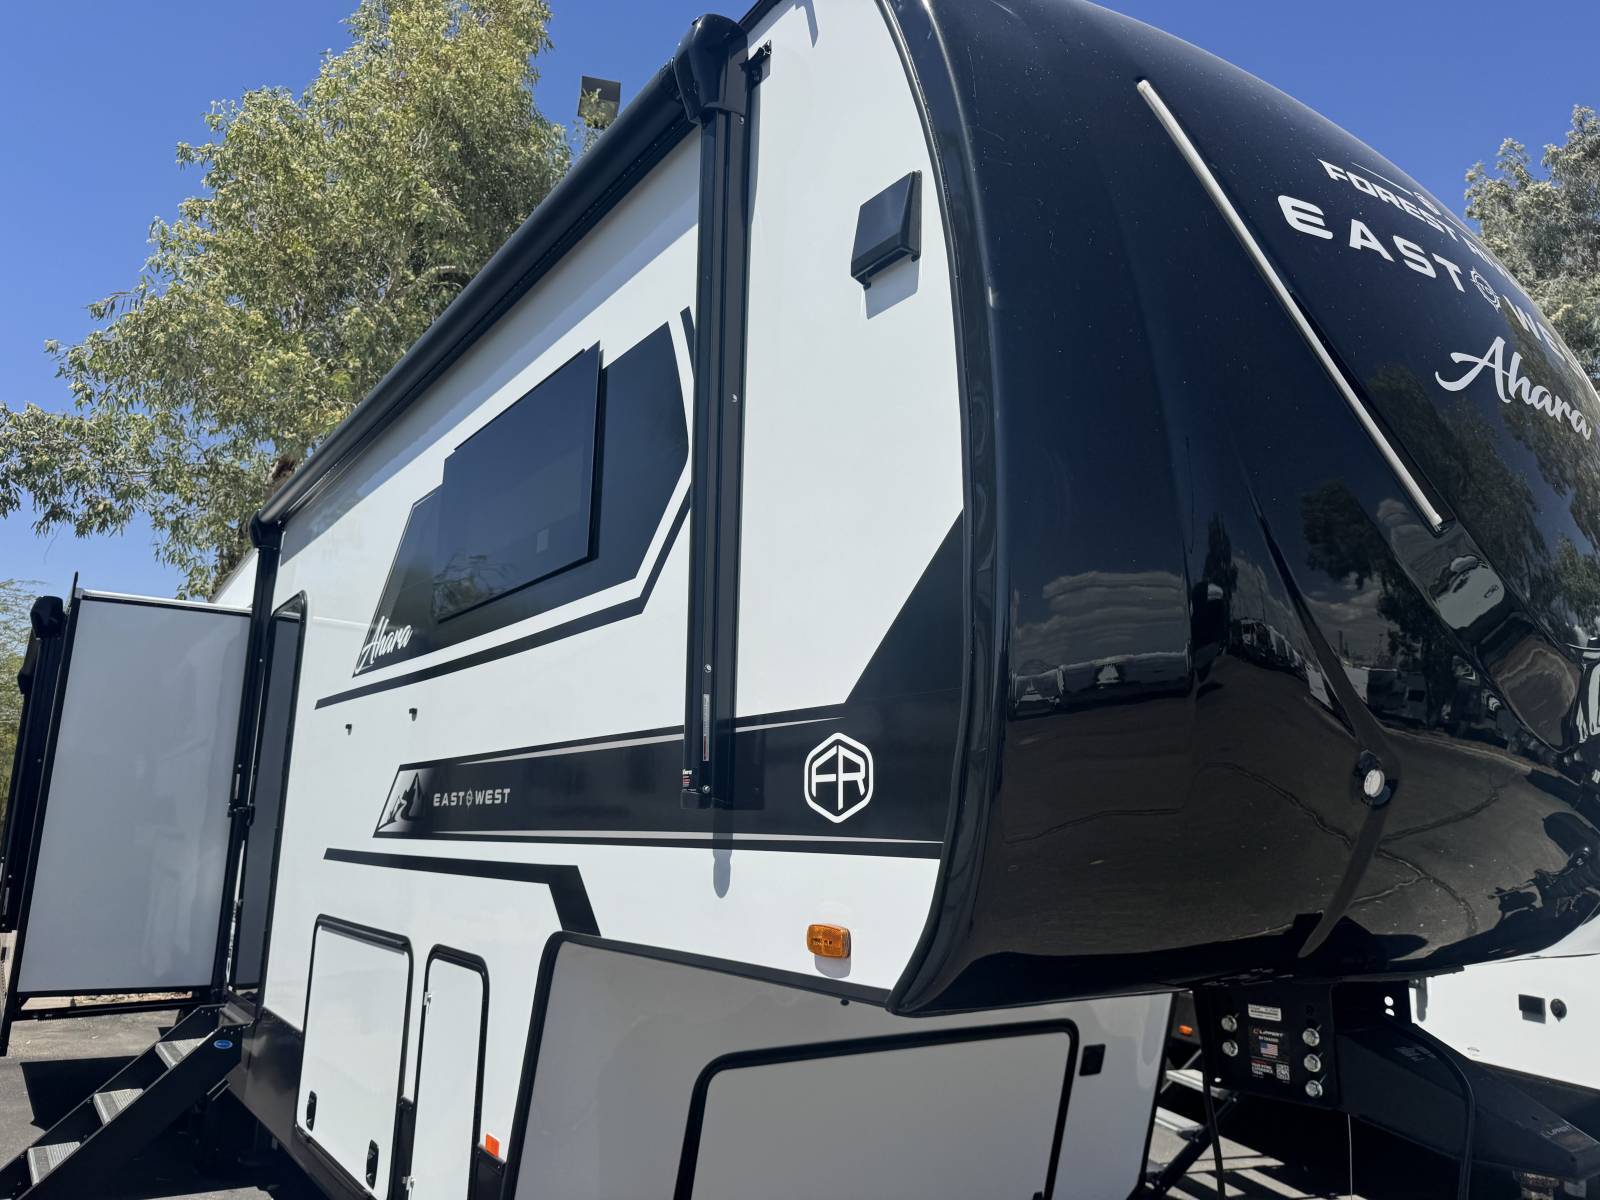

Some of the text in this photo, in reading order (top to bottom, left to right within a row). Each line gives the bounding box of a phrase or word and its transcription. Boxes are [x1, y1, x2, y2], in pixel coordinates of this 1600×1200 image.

[1317, 158, 1459, 242] FOREST
[1277, 194, 1466, 293] EAST
[1434, 336, 1592, 441] Ahara
[354, 615, 414, 675] Ahara
[433, 788, 511, 807] EAST WEST
